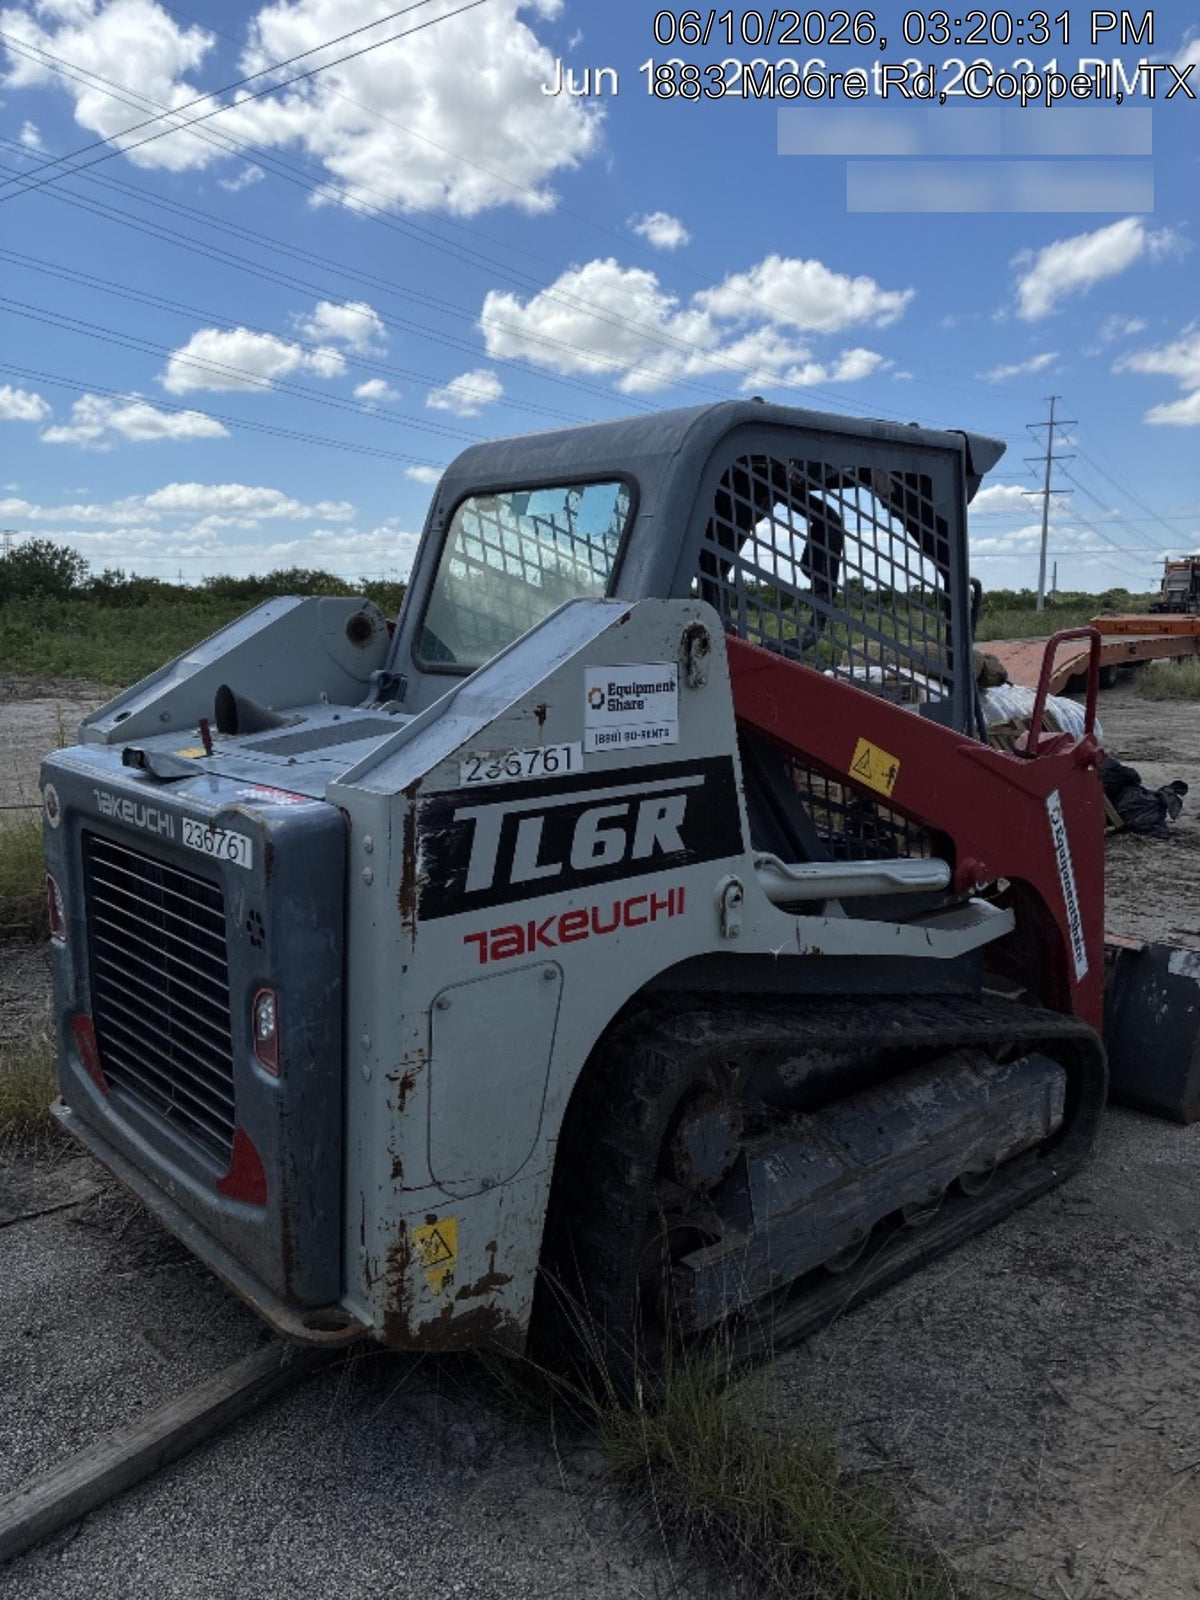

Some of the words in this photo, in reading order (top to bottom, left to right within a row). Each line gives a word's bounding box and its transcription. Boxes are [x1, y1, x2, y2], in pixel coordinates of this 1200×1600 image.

[607, 680, 676, 699] Equipment
[607, 698, 645, 713] Share
[464, 746, 571, 783] 236761
[184, 822, 247, 865] 236761
[453, 775, 704, 893] TL6R
